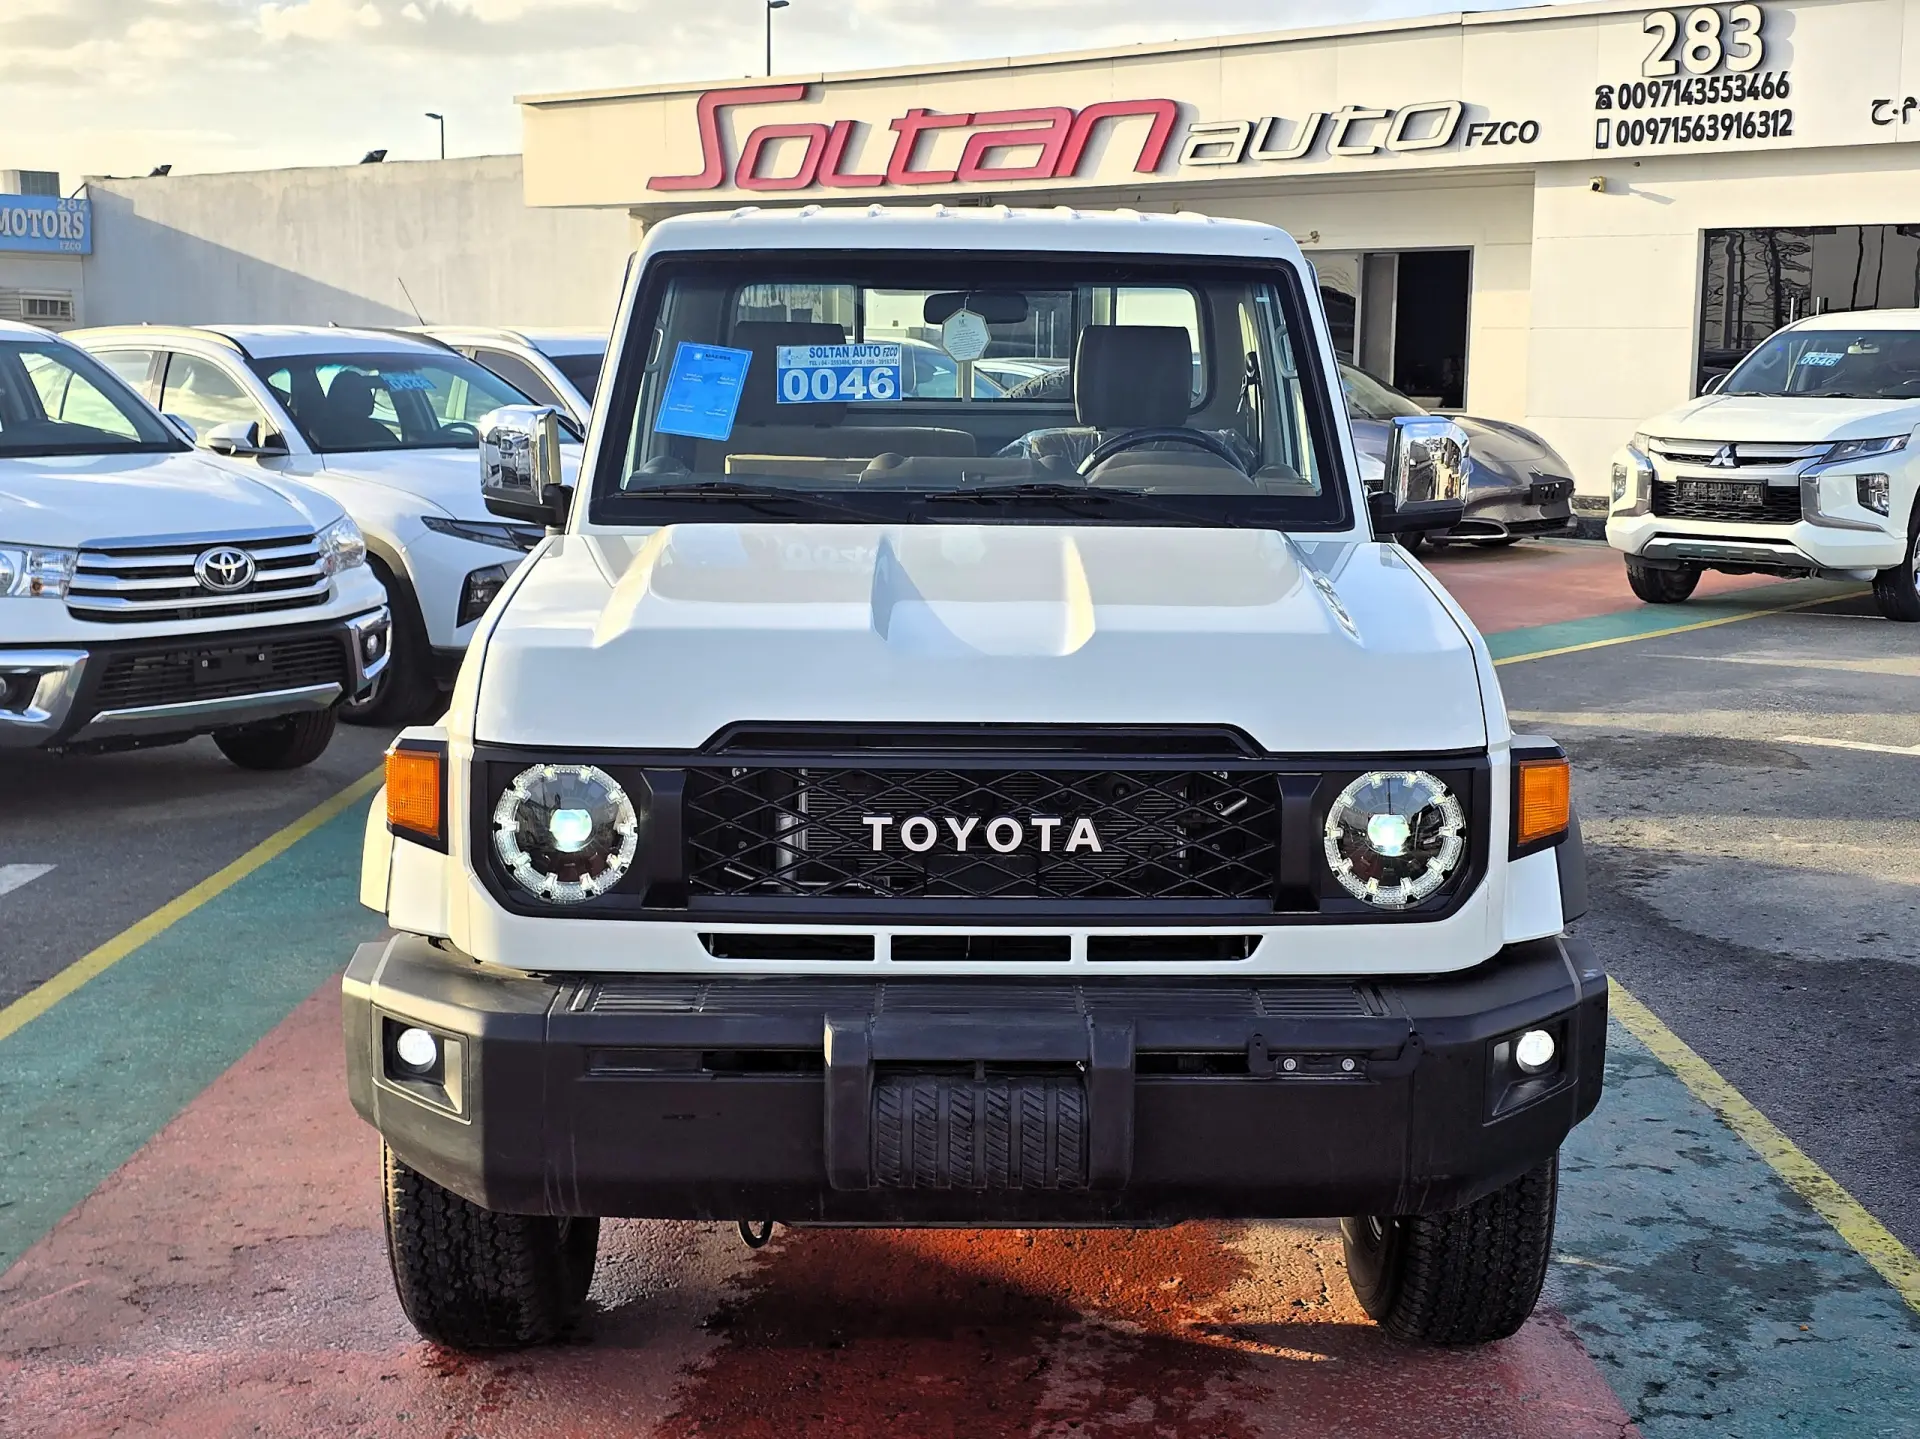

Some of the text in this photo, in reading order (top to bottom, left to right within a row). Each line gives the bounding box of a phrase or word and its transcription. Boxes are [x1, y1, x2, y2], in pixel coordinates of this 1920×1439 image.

[1641, 4, 1766, 77] 283
[1617, 71, 1791, 110] 0097143553466
[1464, 120, 1540, 148] FZCO
[1616, 109, 1793, 147] 00971563916312
[809, 346, 850, 359] SOLTAN
[852, 345, 880, 358] AUTO
[882, 346, 898, 357] FZCO
[1800, 357, 1837, 366] 0046
[783, 367, 895, 401] 0046
[862, 815, 1104, 853] TOYOTA
